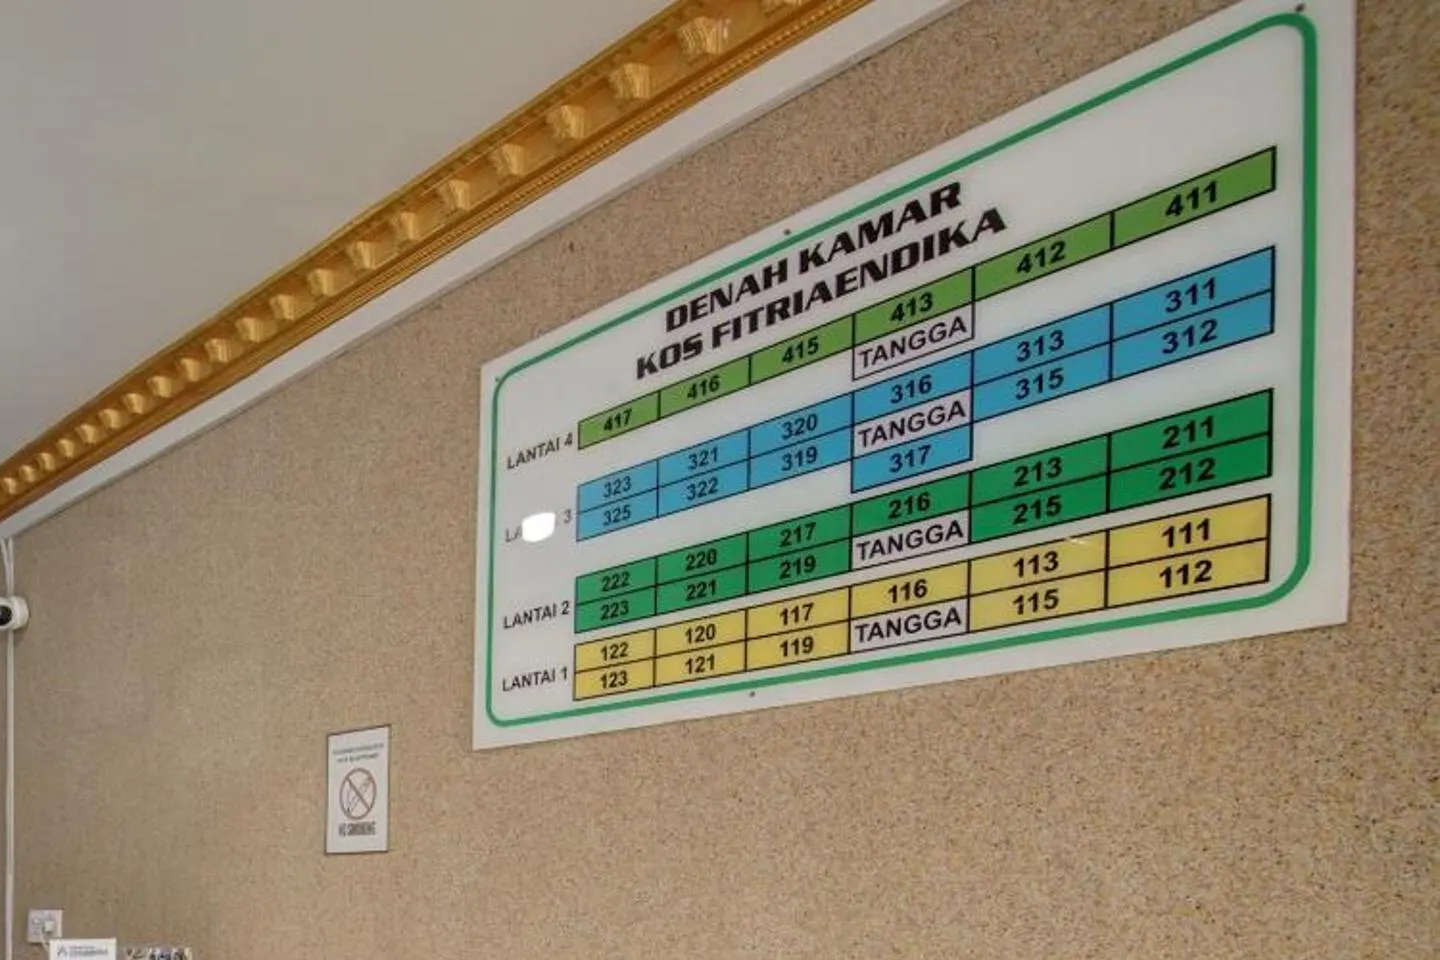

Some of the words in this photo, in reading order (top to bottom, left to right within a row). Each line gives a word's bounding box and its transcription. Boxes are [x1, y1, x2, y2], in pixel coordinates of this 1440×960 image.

[603, 409, 633, 432] 417
[687, 376, 720, 400] 416
[782, 335, 819, 365] 415
[889, 292, 933, 322] 413
[1016, 241, 1066, 273] 412
[1165, 180, 1217, 217] 411
[636, 334, 703, 379] KOS
[711, 207, 1007, 348] FITRIAENDIKA
[666, 258, 788, 332] DENAH
[798, 181, 960, 274] KAMAR
[603, 476, 632, 499] 323
[687, 447, 719, 471] 321
[781, 413, 818, 441] 320
[890, 374, 932, 404] 316
[1016, 330, 1065, 363] 313
[1165, 277, 1216, 313] 311
[858, 316, 967, 369] TANGGA
[506, 441, 560, 470] LANTAI
[564, 432, 573, 447] 4
[602, 507, 631, 527] 325
[686, 477, 718, 501] 322
[781, 446, 818, 472] 319
[858, 400, 966, 448] TANGGA
[1015, 367, 1064, 400] 315
[1162, 319, 1218, 355] 312
[889, 445, 931, 473] 317
[564, 509, 572, 523] 3
[600, 573, 630, 593] 222
[685, 548, 718, 571] 220
[779, 522, 817, 548] 217
[888, 492, 930, 520] 216
[1014, 457, 1062, 486] 213
[1163, 416, 1214, 449] 211
[600, 600, 630, 620] 223
[686, 581, 717, 601] 221
[779, 554, 817, 579] 219
[856, 520, 964, 561] TANGGA
[1014, 495, 1062, 524] 215
[1159, 458, 1216, 490] 212
[503, 606, 559, 629] LANTAI
[561, 600, 570, 615] 2
[600, 642, 629, 661] 122
[685, 623, 716, 644] 120
[779, 603, 815, 626] 117
[888, 579, 928, 604] 116
[1013, 552, 1059, 578] 113
[1162, 518, 1210, 548] 111
[600, 670, 628, 689] 123
[685, 654, 715, 674] 121
[779, 636, 814, 658] 119
[855, 607, 962, 643] TANGGA
[1013, 589, 1059, 615] 115
[1159, 560, 1212, 588] 112
[502, 670, 558, 692] LANTAI
[562, 668, 568, 681] 1
